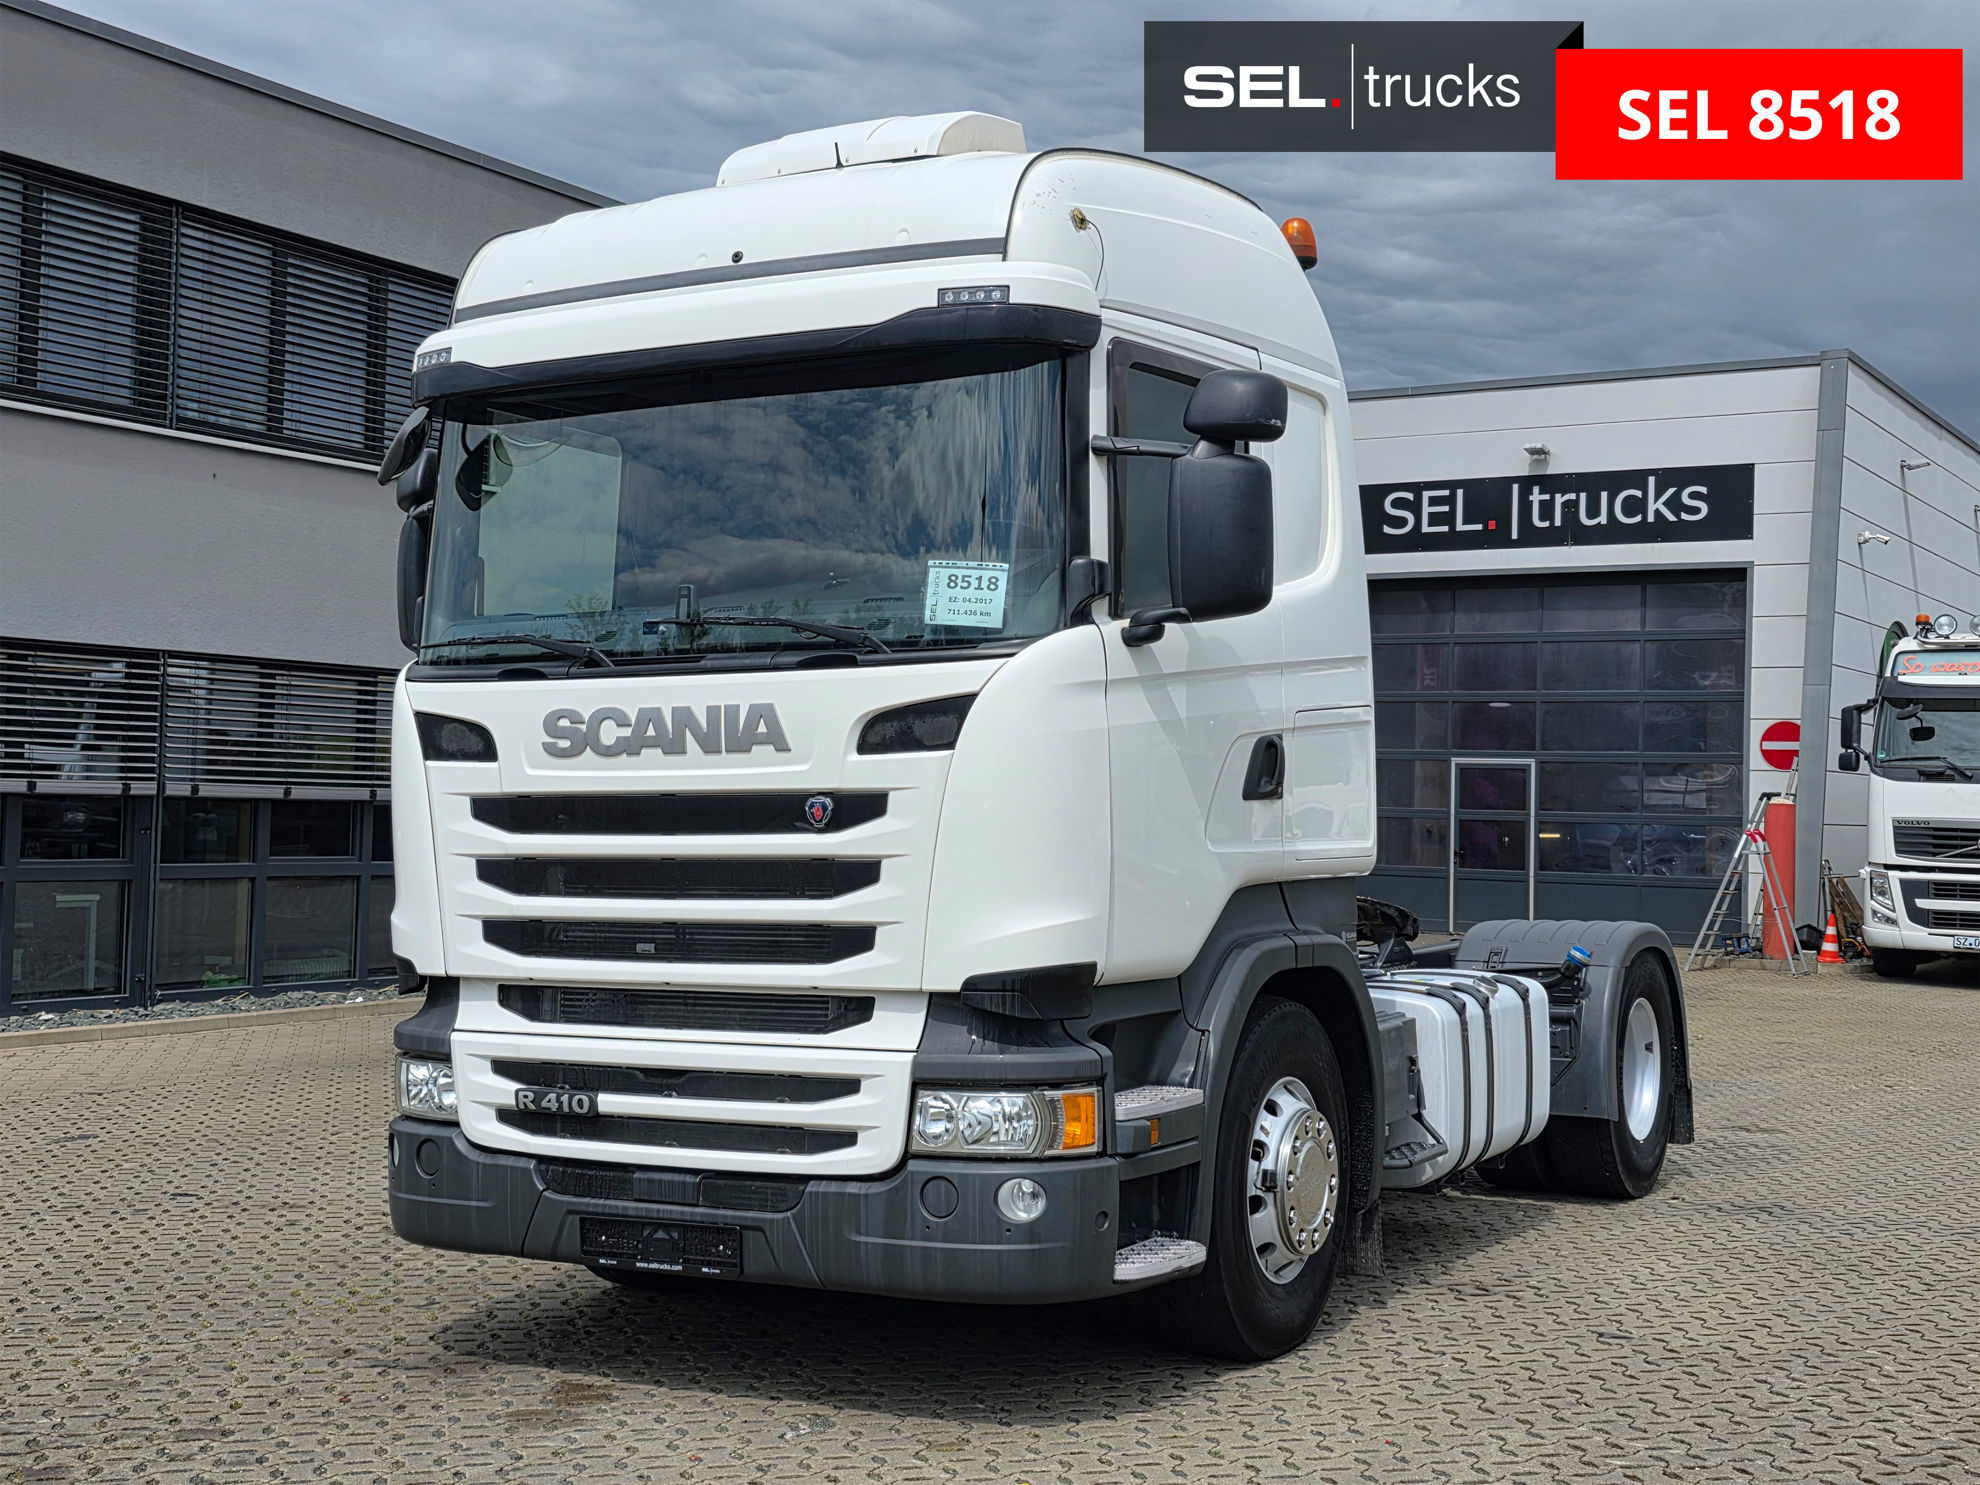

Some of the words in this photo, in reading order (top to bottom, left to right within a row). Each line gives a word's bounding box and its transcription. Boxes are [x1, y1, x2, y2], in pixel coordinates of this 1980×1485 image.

[1528, 475, 1709, 528] trucks
[946, 573, 1000, 592] 8518
[962, 597, 993, 605] 04.2017
[947, 608, 978, 617] 711.436
[541, 702, 792, 758] SCANIA
[1896, 819, 1931, 827] VOLVO
[1955, 937, 1968, 946] SZ
[517, 1091, 536, 1110] R
[541, 1093, 590, 1114] 410
